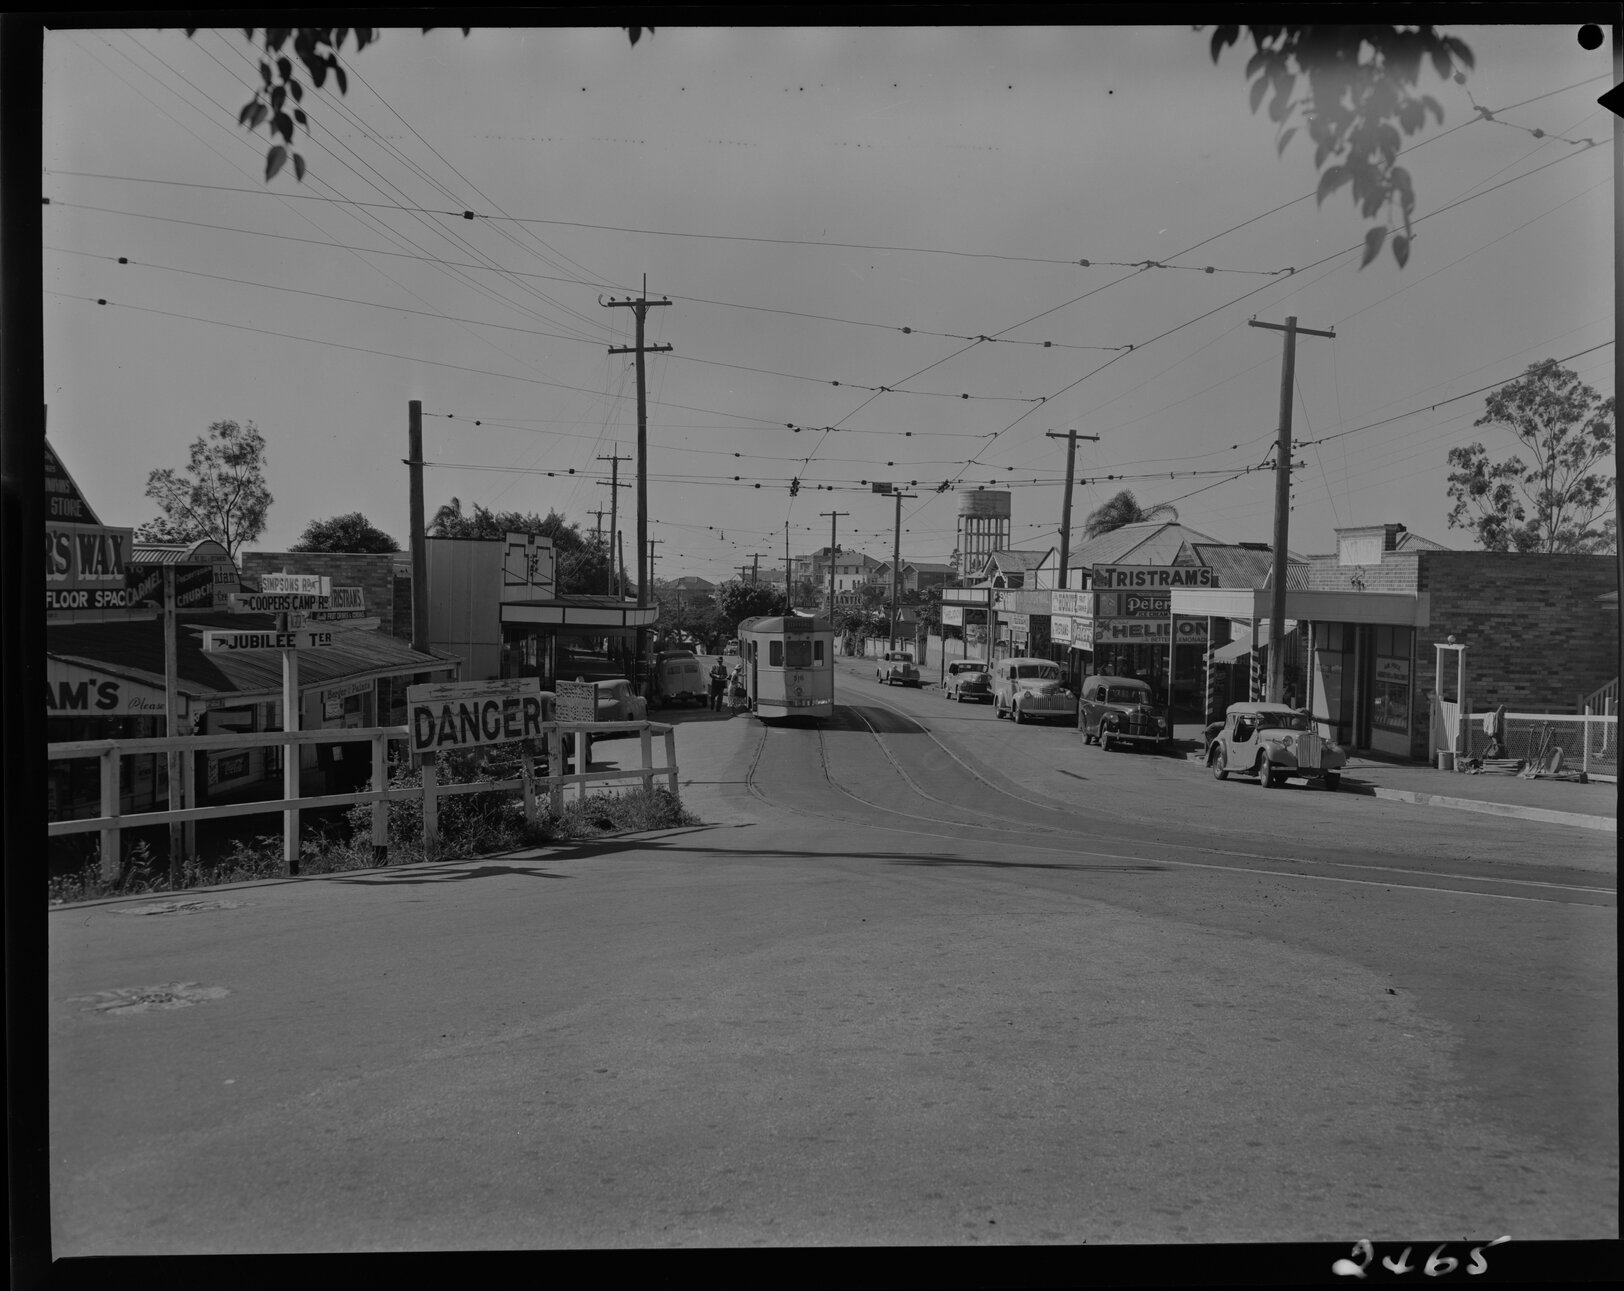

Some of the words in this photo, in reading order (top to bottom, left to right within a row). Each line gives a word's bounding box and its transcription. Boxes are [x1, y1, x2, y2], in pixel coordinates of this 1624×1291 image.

[51, 497, 82, 517] STORE
[77, 534, 124, 580] WAX
[263, 578, 299, 592] SIMPSONS
[1105, 568, 1210, 588] TRISTRAM'S
[126, 570, 162, 607] CARMEL
[177, 582, 212, 607] CHURCH
[47, 591, 88, 608] FLOOR
[95, 591, 126, 607] SPAC
[249, 595, 290, 611] COOPERS
[292, 595, 316, 610] CAMP
[228, 634, 296, 649] JUBILEE
[128, 697, 165, 711] Please
[414, 697, 541, 749] DANGER
